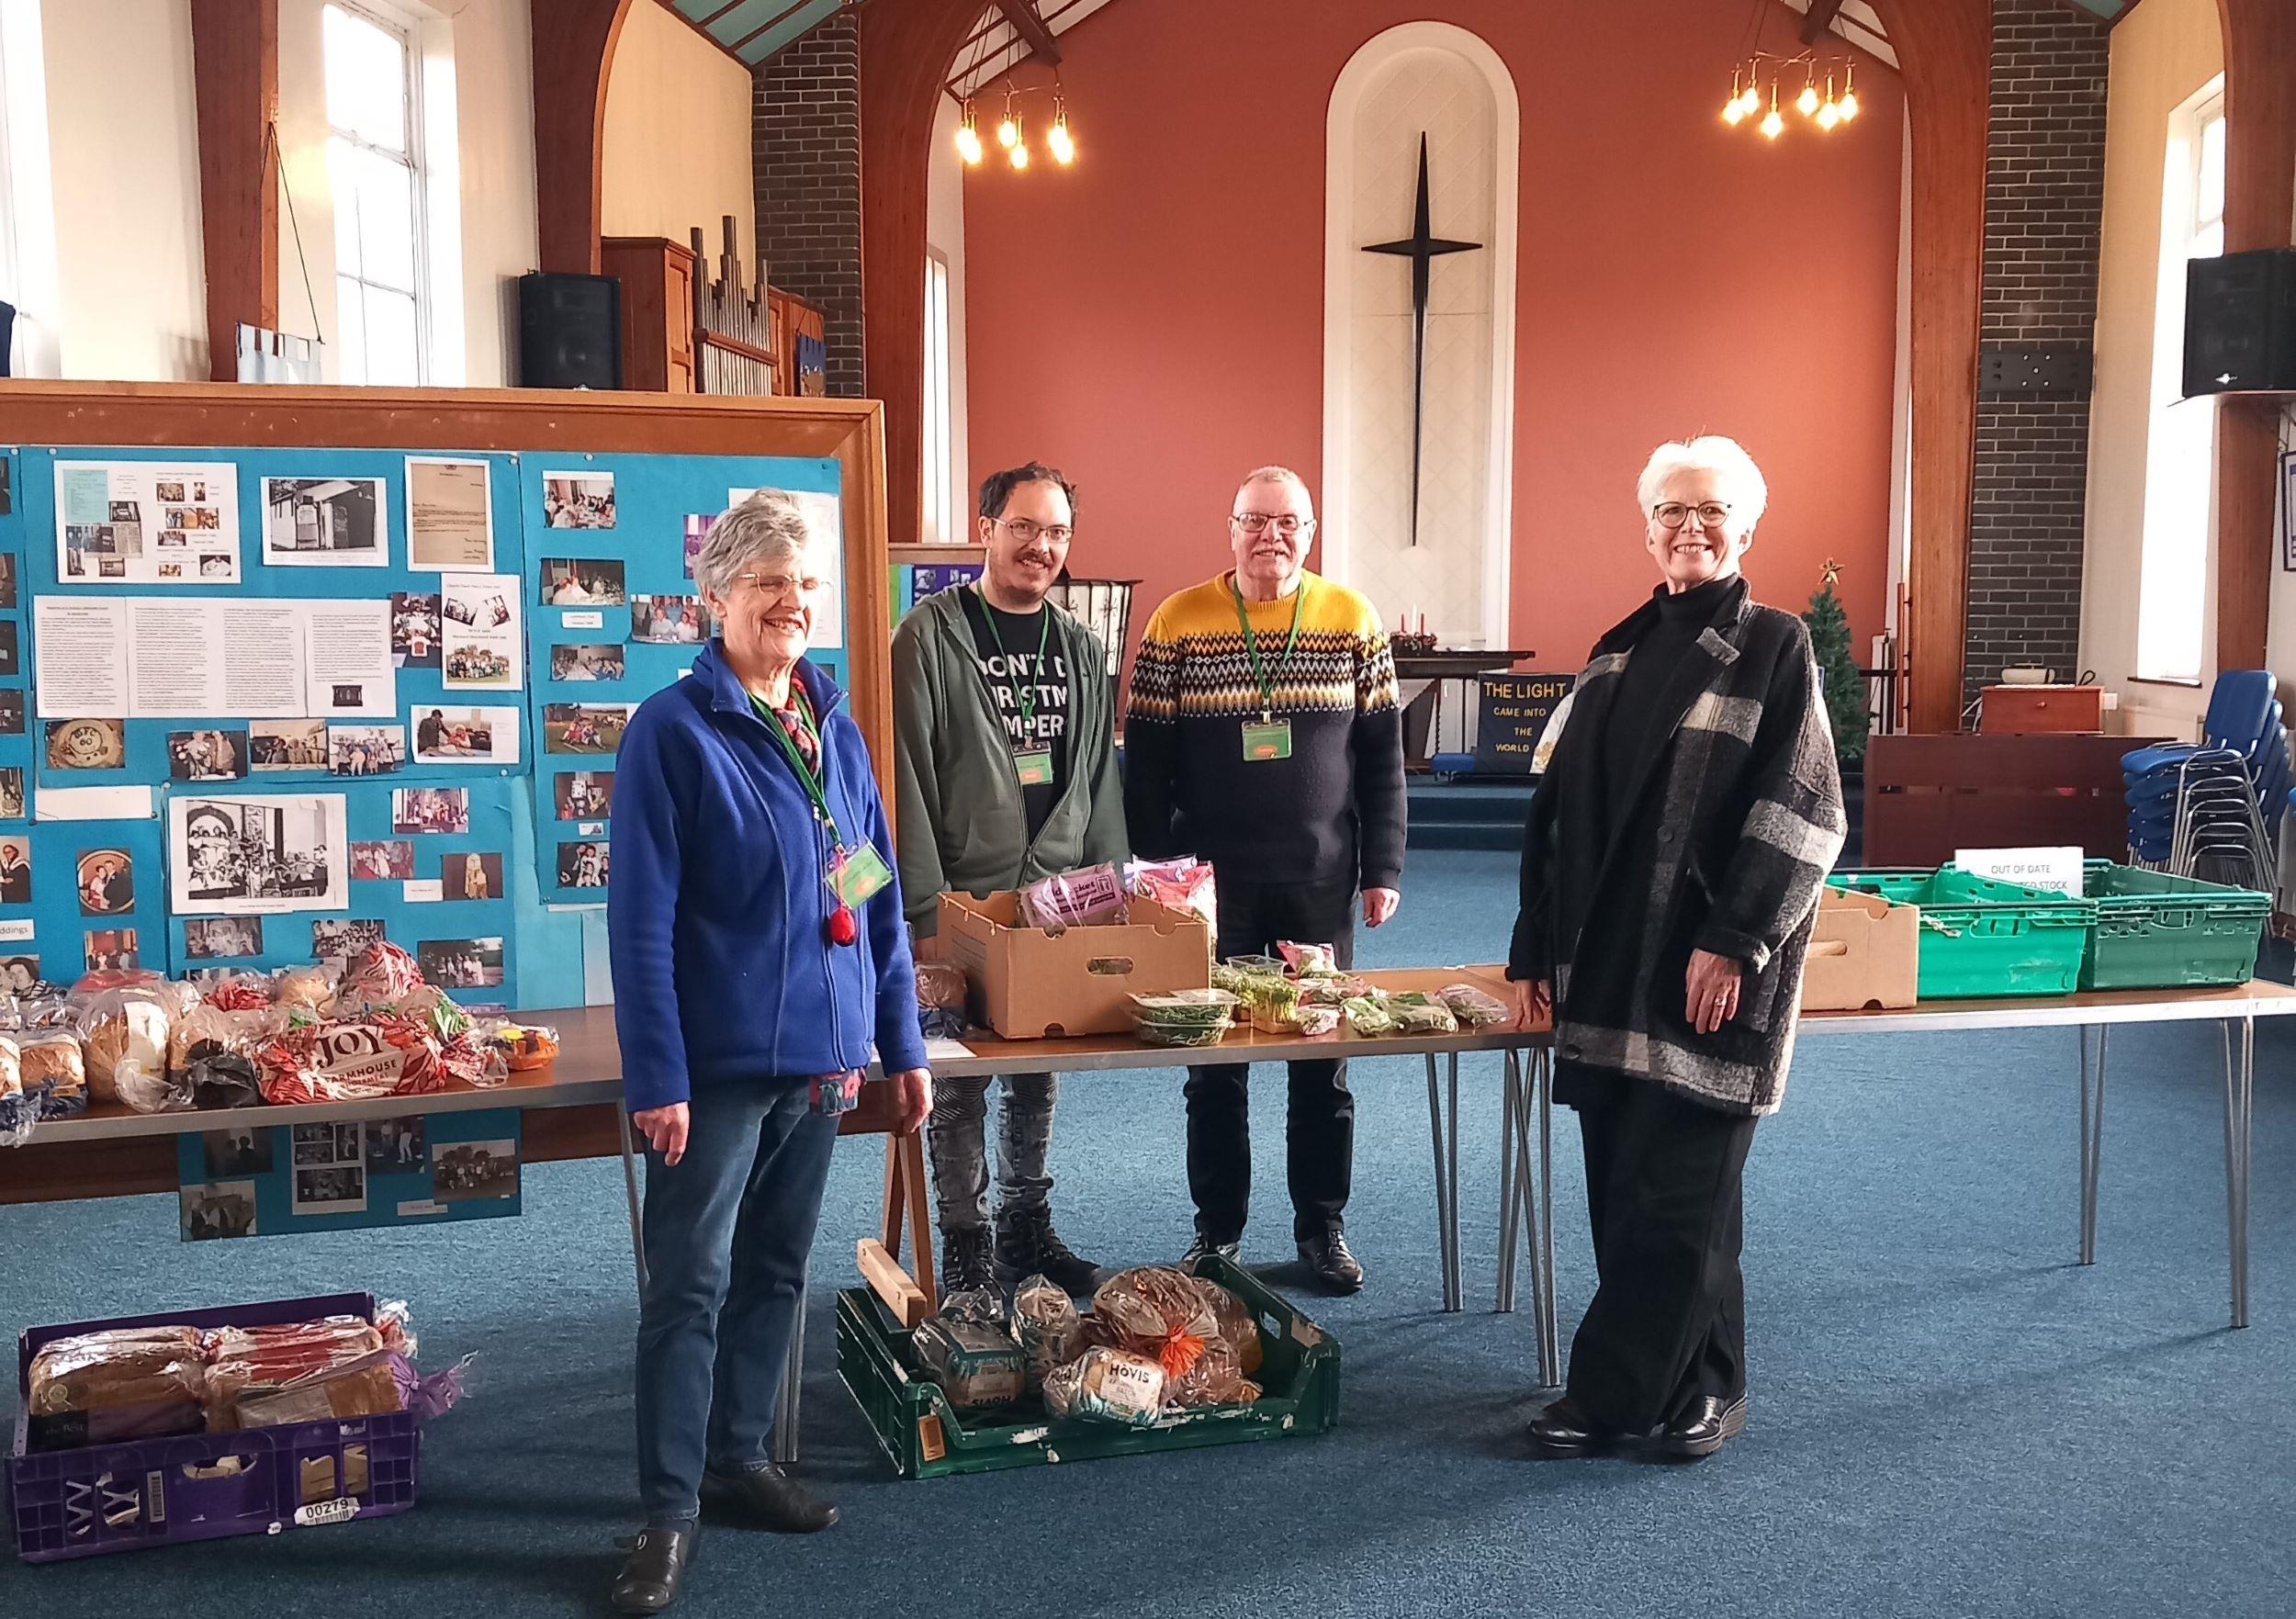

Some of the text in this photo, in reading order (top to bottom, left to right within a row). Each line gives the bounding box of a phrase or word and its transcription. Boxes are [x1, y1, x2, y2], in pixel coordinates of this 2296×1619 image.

[1053, 656, 1067, 678] D
[1483, 681, 1567, 699] THE LIGHT
[1493, 706, 1547, 717] CAME INTO
[1001, 714, 1064, 738] MPER
[1514, 726, 1533, 736] THE
[1495, 743, 1529, 753] WORLD
[1991, 863, 2051, 874] OUT OF DATE
[2039, 881, 2068, 891] STOCK
[0, 926, 28, 935] ddings
[316, 1027, 383, 1069] JOY
[325, 1059, 398, 1084] FARMHOUSE
[305, 1499, 349, 1519] 00279
